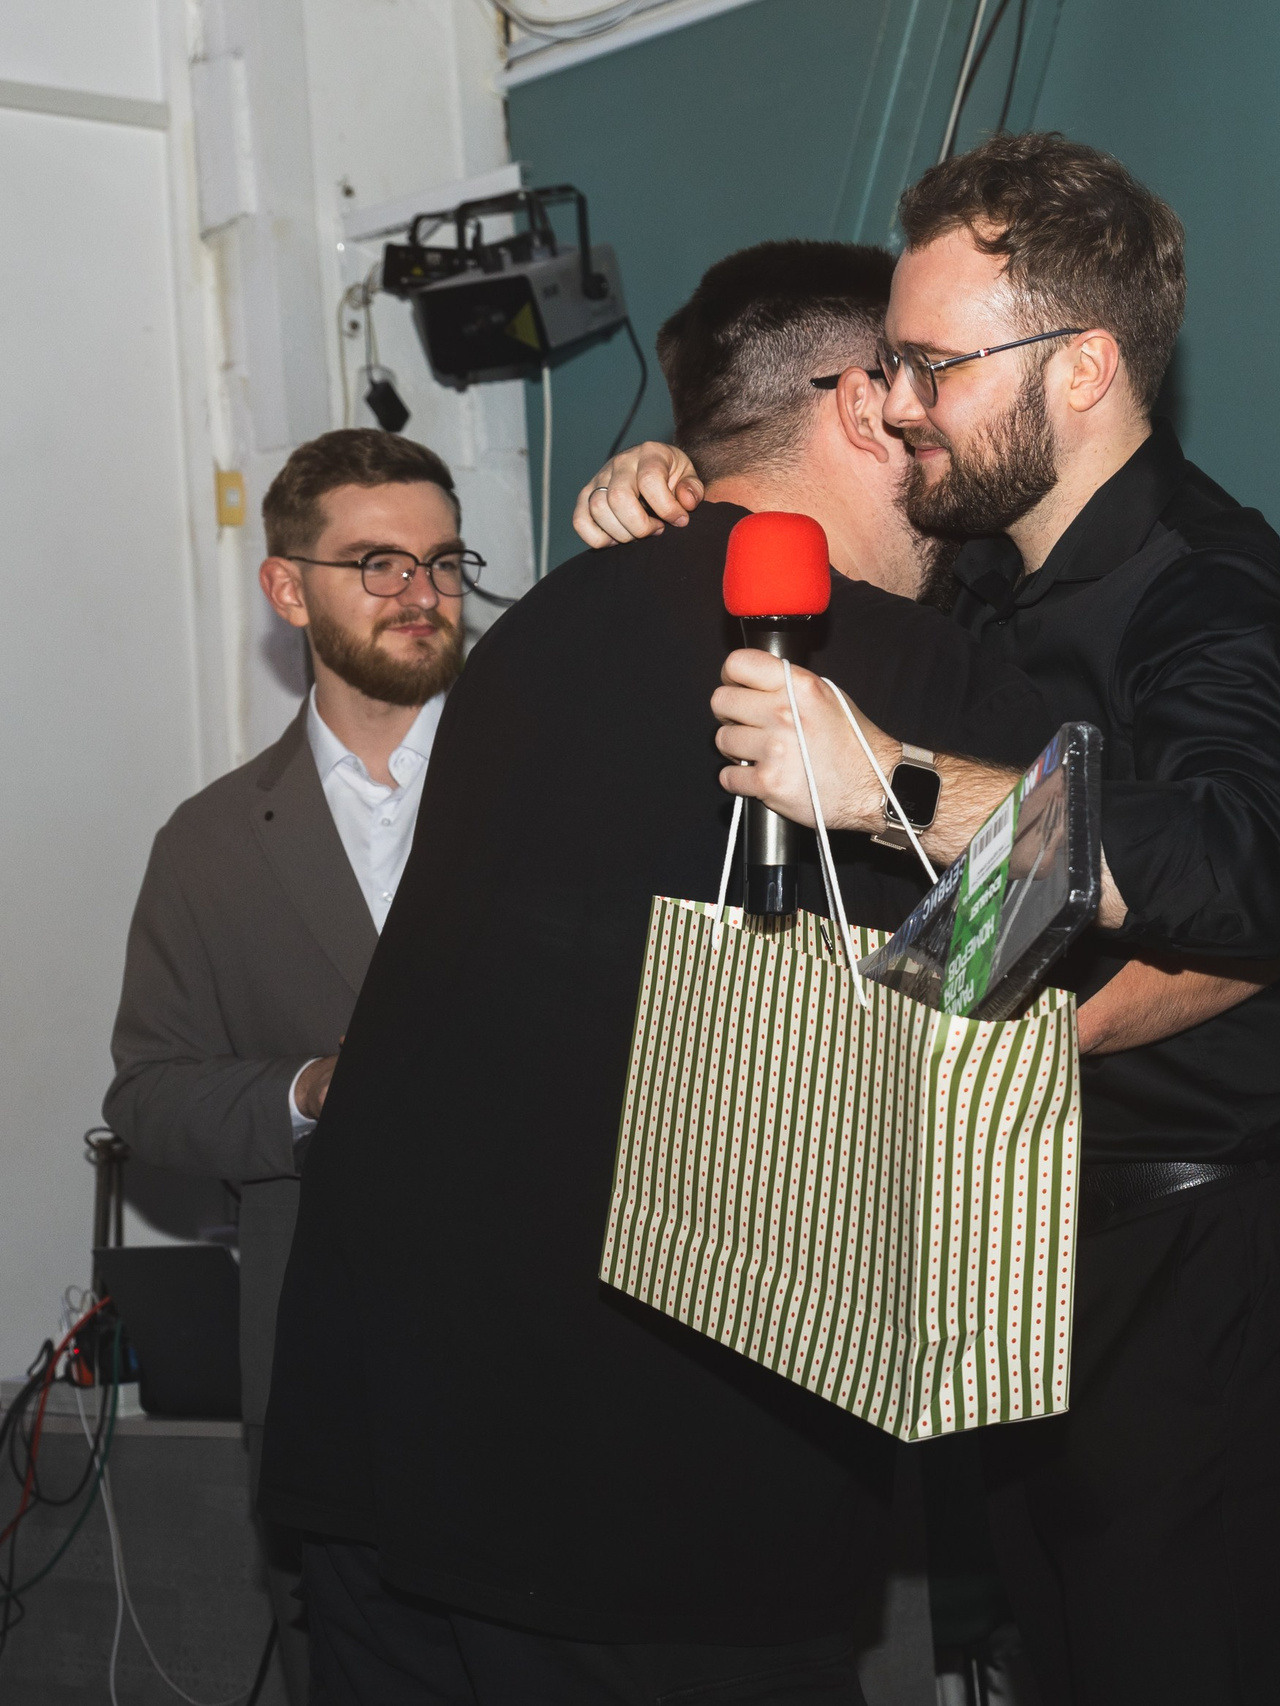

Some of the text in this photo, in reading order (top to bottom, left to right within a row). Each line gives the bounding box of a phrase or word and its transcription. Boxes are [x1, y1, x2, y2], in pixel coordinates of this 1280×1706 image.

[948, 914, 995, 982] НОМЕРОВ
[940, 967, 967, 1008] ДЛЯ
[941, 979, 975, 1015] РАМК
